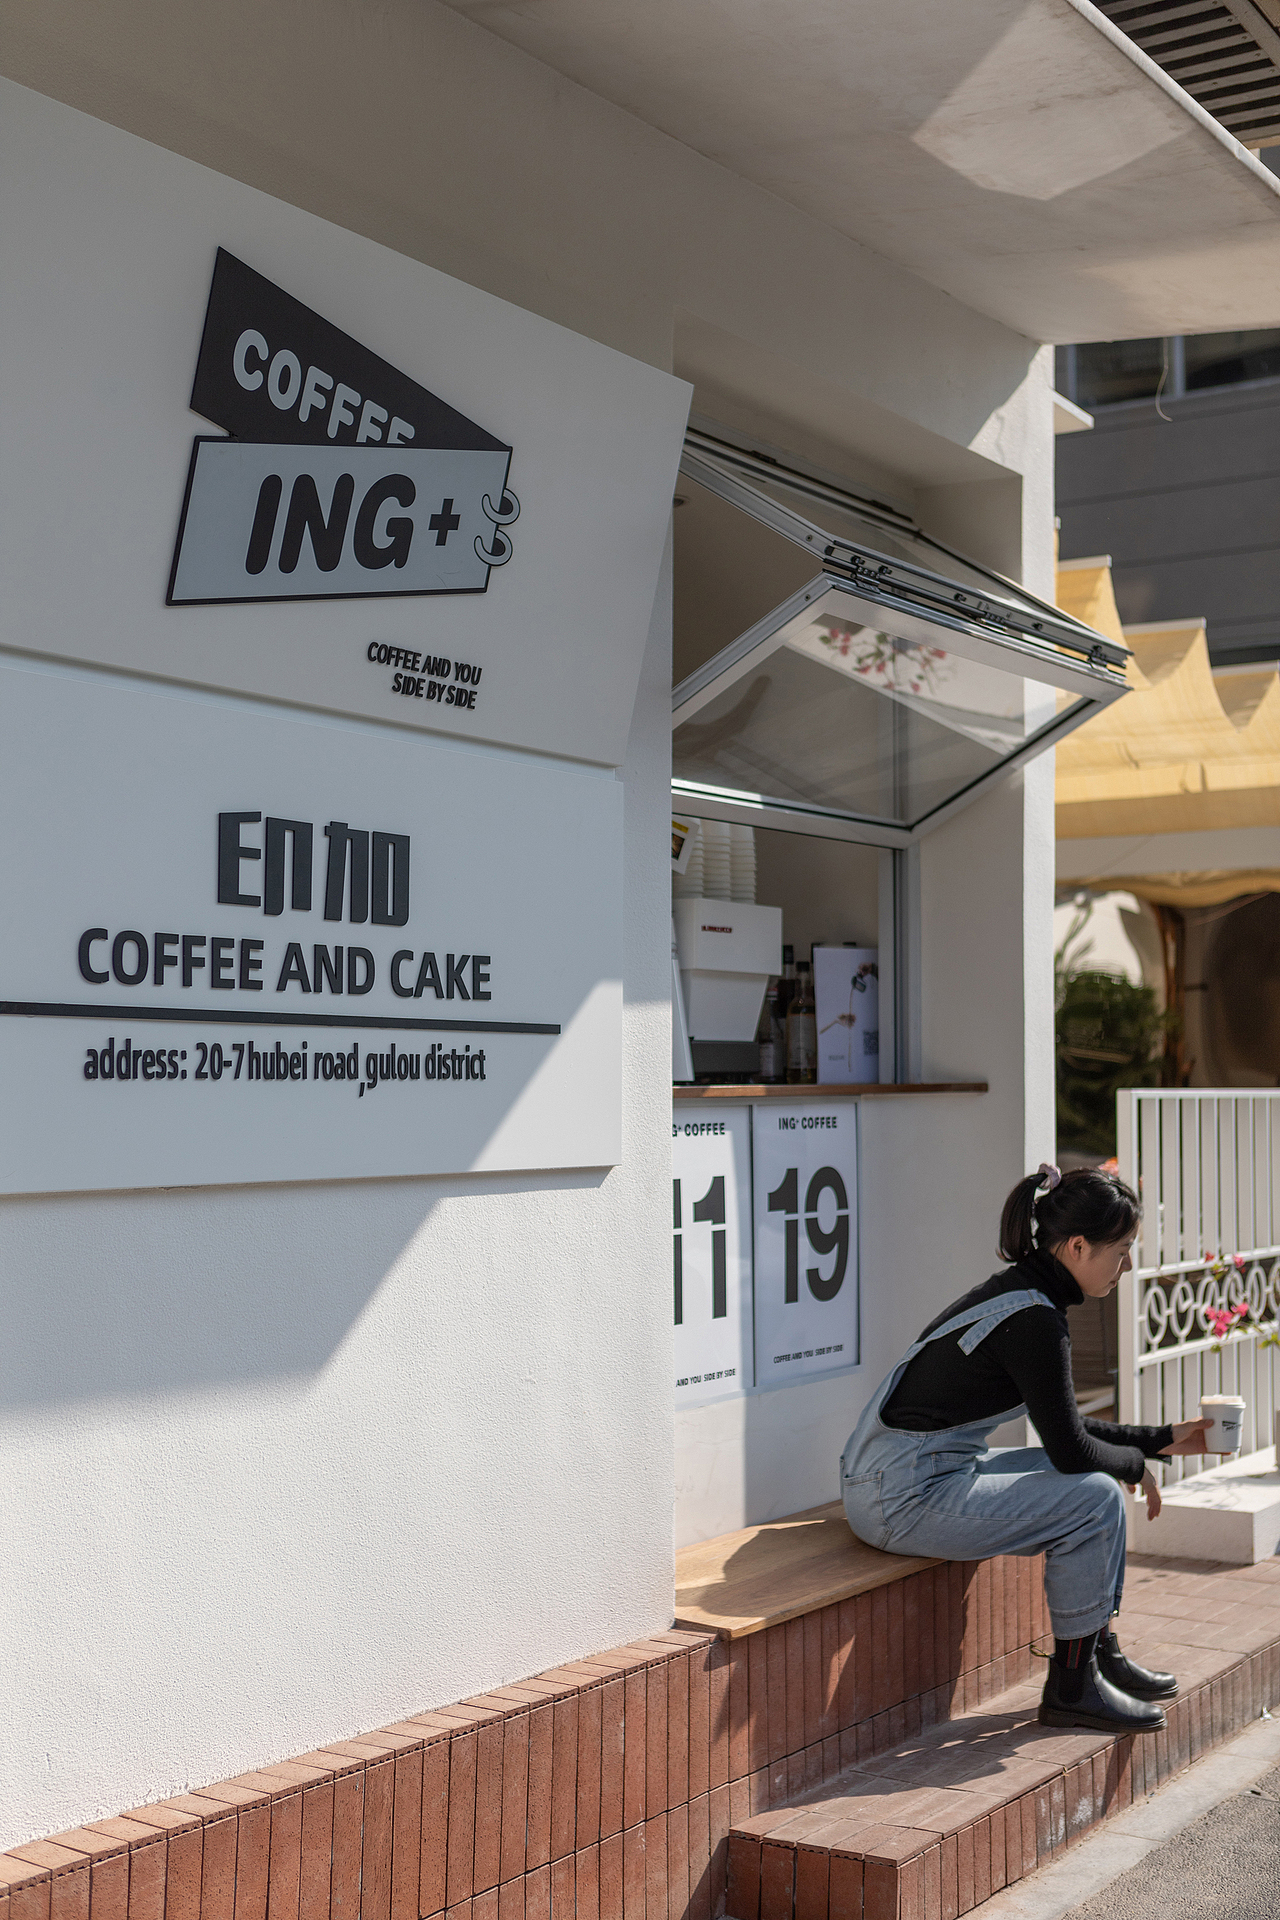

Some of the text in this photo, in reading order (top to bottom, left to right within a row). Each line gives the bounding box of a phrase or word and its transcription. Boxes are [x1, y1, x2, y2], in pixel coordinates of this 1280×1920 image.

[367, 641, 483, 686] COFFEE AND YOU
[391, 672, 478, 710] SIDE BY SIDE
[78, 927, 492, 1001] COFFEE AND CAKE
[84, 1037, 188, 1081] address:
[425, 1043, 486, 1081] district
[684, 1122, 726, 1137] COFFEE
[801, 1116, 838, 1130] COFFEE
[767, 1166, 850, 1304] 19
[773, 1344, 844, 1364] COFFEE AND YOU SIDE BY SIDE
[676, 1368, 736, 1388] AND YOU SIDE BY SIDE
